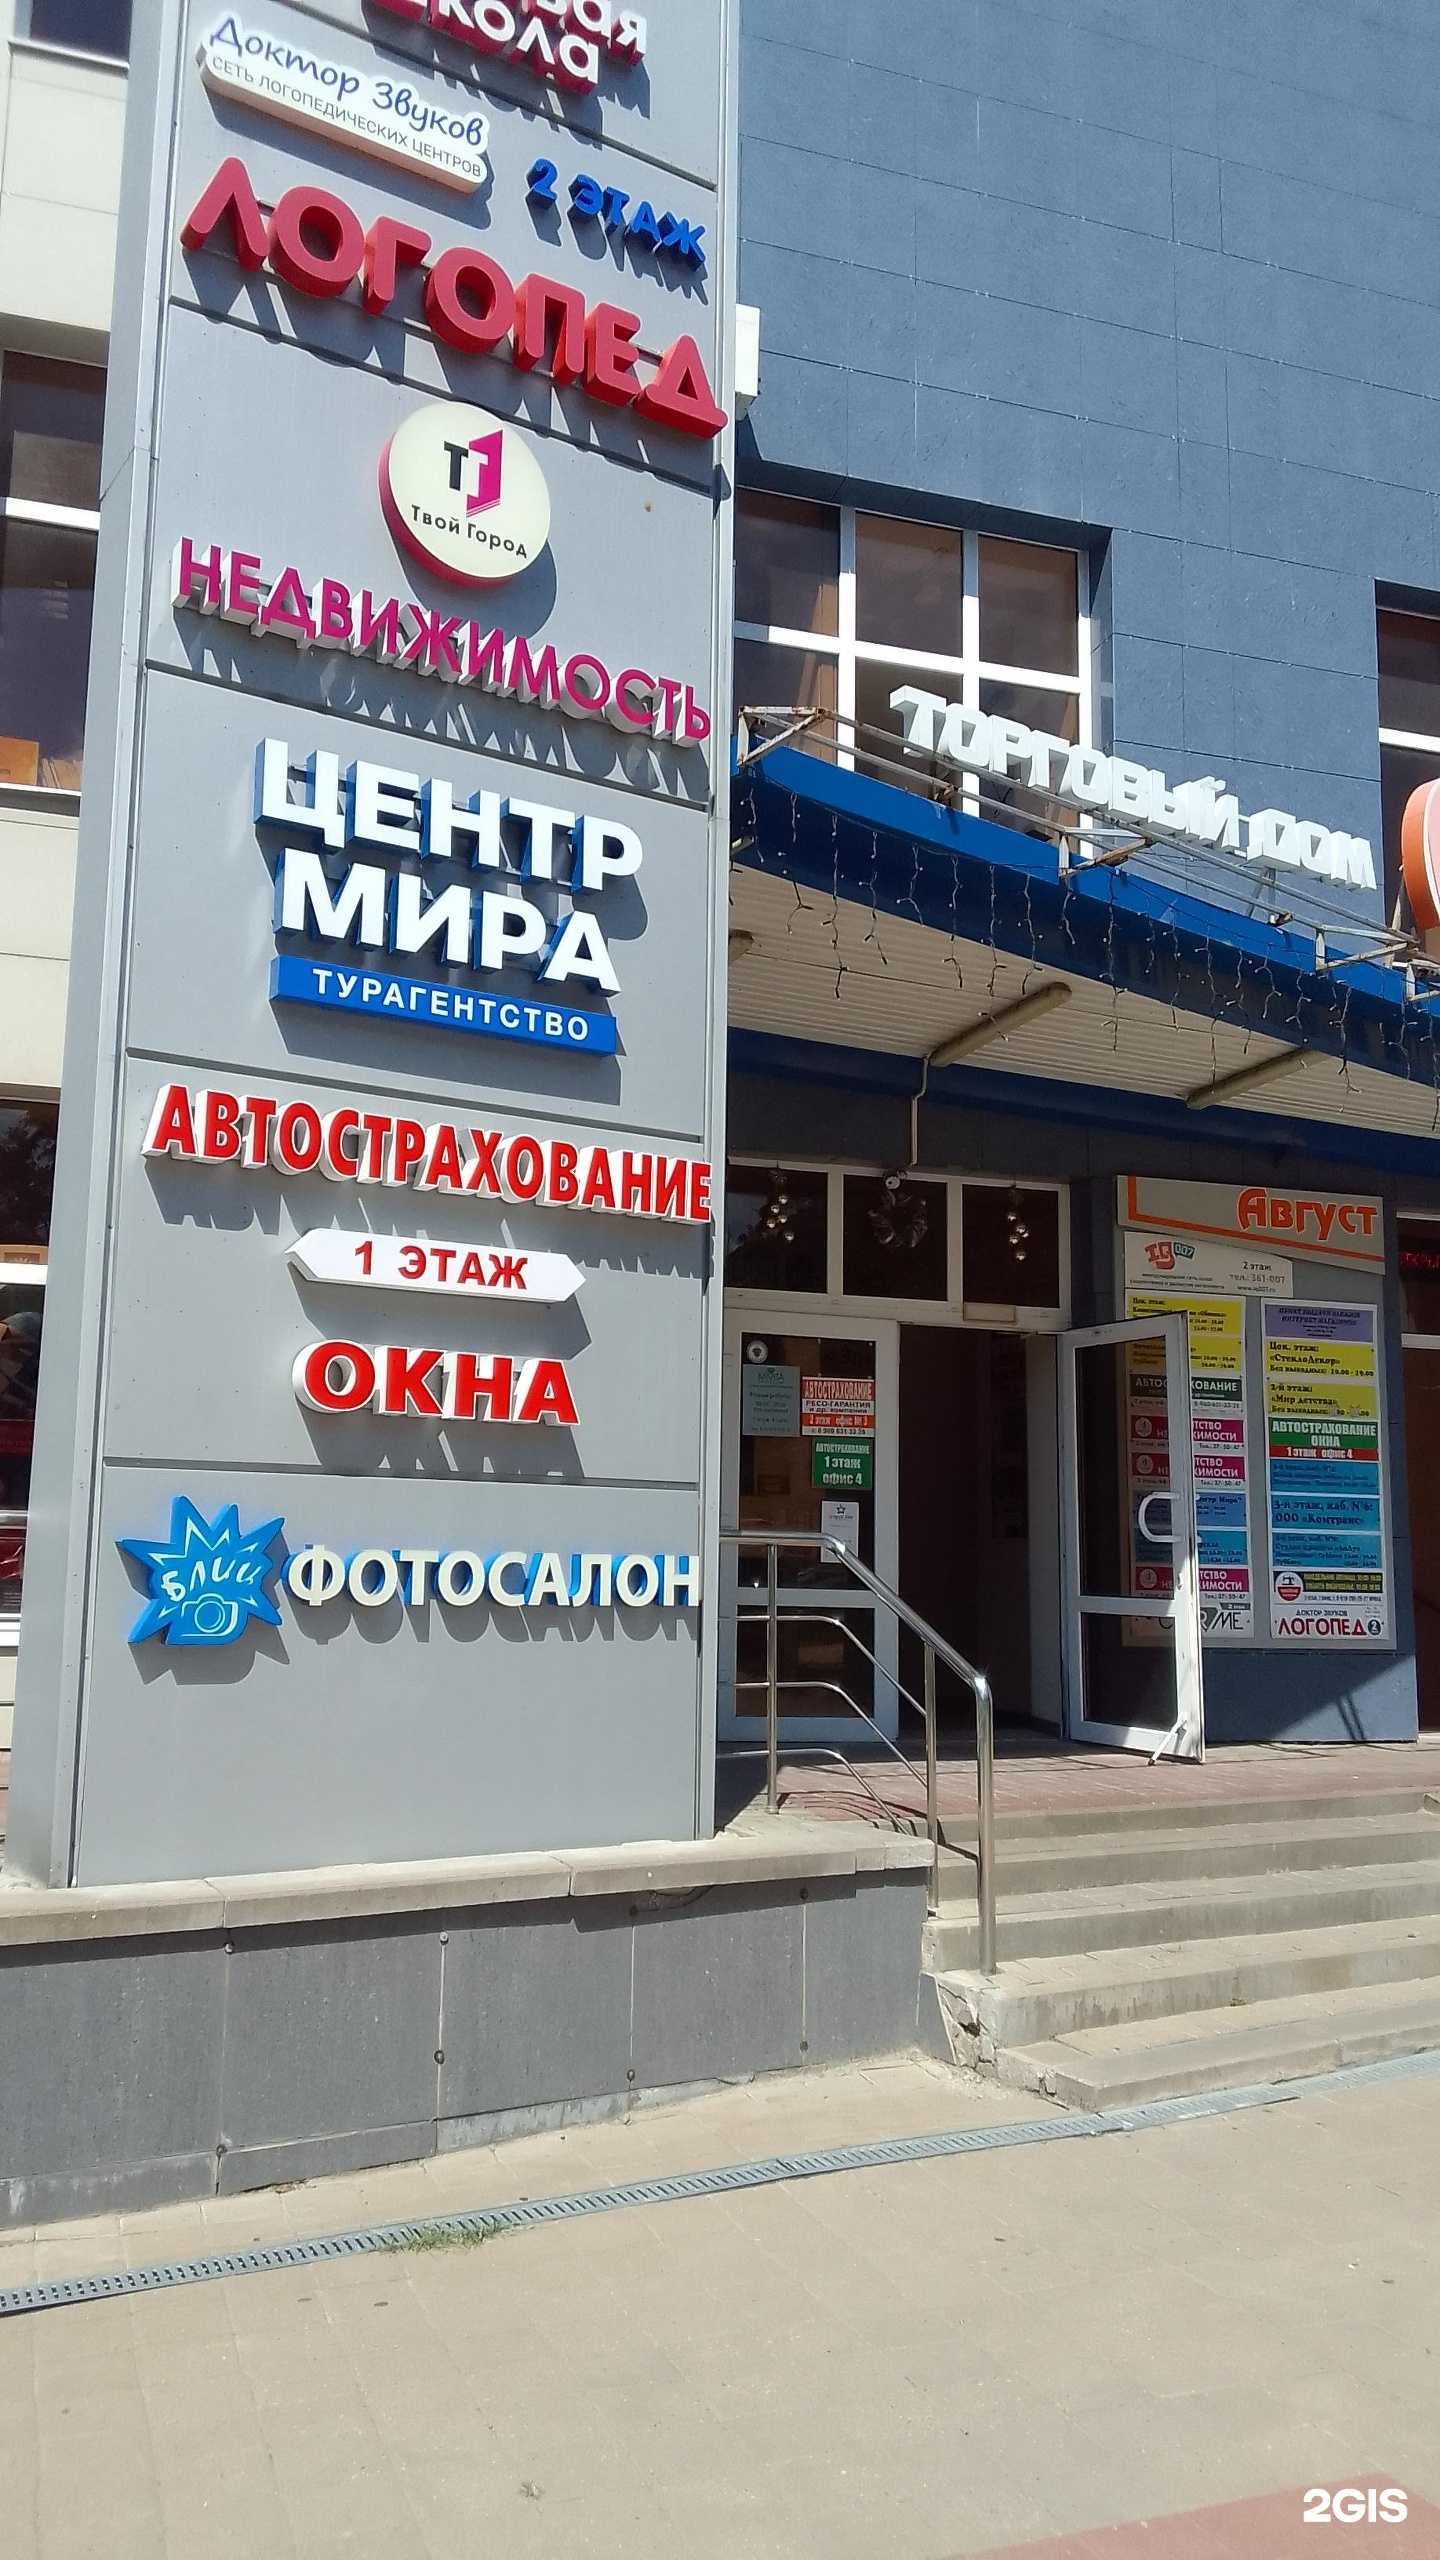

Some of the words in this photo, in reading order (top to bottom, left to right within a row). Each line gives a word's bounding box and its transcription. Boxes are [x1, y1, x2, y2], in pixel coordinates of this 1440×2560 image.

[388, 0, 599, 85] кола
[209, 16, 360, 101] Доктор
[372, 81, 484, 147] Звуков
[212, 56, 254, 83] СЕТЬ
[259, 70, 408, 147] ЛОГОПЕДИЧЕСКИХ
[412, 138, 482, 178] ЦЕНТРОВ
[526, 158, 557, 209] 2
[568, 174, 707, 271] ЭТАЖ
[180, 157, 727, 438] ЛОГОПЕД
[411, 503, 461, 535] Твой
[467, 522, 528, 559] Город
[173, 537, 711, 746] НЕДВИЖИМОСТЬ
[255, 738, 643, 892] ЦЕНТР
[889, 684, 1240, 847] ТОРГОВЫЙ
[1247, 808, 1377, 889] ДОМ
[274, 847, 621, 997] МИРА
[312, 968, 589, 1042] ТУРАГЕНТСТВО
[143, 1084, 712, 1224] АВТОСТРАХОВАНИЕ
[1237, 1187, 1378, 1241] Август
[355, 1240, 374, 1275] 1
[398, 1245, 528, 1290] ЭТАЖ
[294, 1339, 580, 1426] ОКНА
[804, 1380, 873, 1400] АВТОСТРАХОВАНИЕ
[806, 1400, 871, 1408] РЕСО-ГАРАНТИЯ
[816, 1443, 870, 1454] АВТОСТРАХОВАНИЕ
[1272, 1420, 1377, 1436] АВТОСТРАХОВАНИЕ
[1286, 1447, 1293, 1457] 1
[1293, 1448, 1317, 1458] этаж
[1321, 1449, 1346, 1459] офис
[1346, 1449, 1353, 1459] 4
[1311, 1435, 1340, 1447] ОКНА
[823, 1472, 854, 1485] офис
[855, 1473, 863, 1485] 4
[824, 1455, 830, 1468] 1
[832, 1457, 861, 1469] этаж
[283, 1544, 701, 1609] ФОТОСАЛОН
[1278, 1617, 1367, 1636] ЛОГОПЕД
[1296, 1609, 1322, 1617] ДОКТОР
